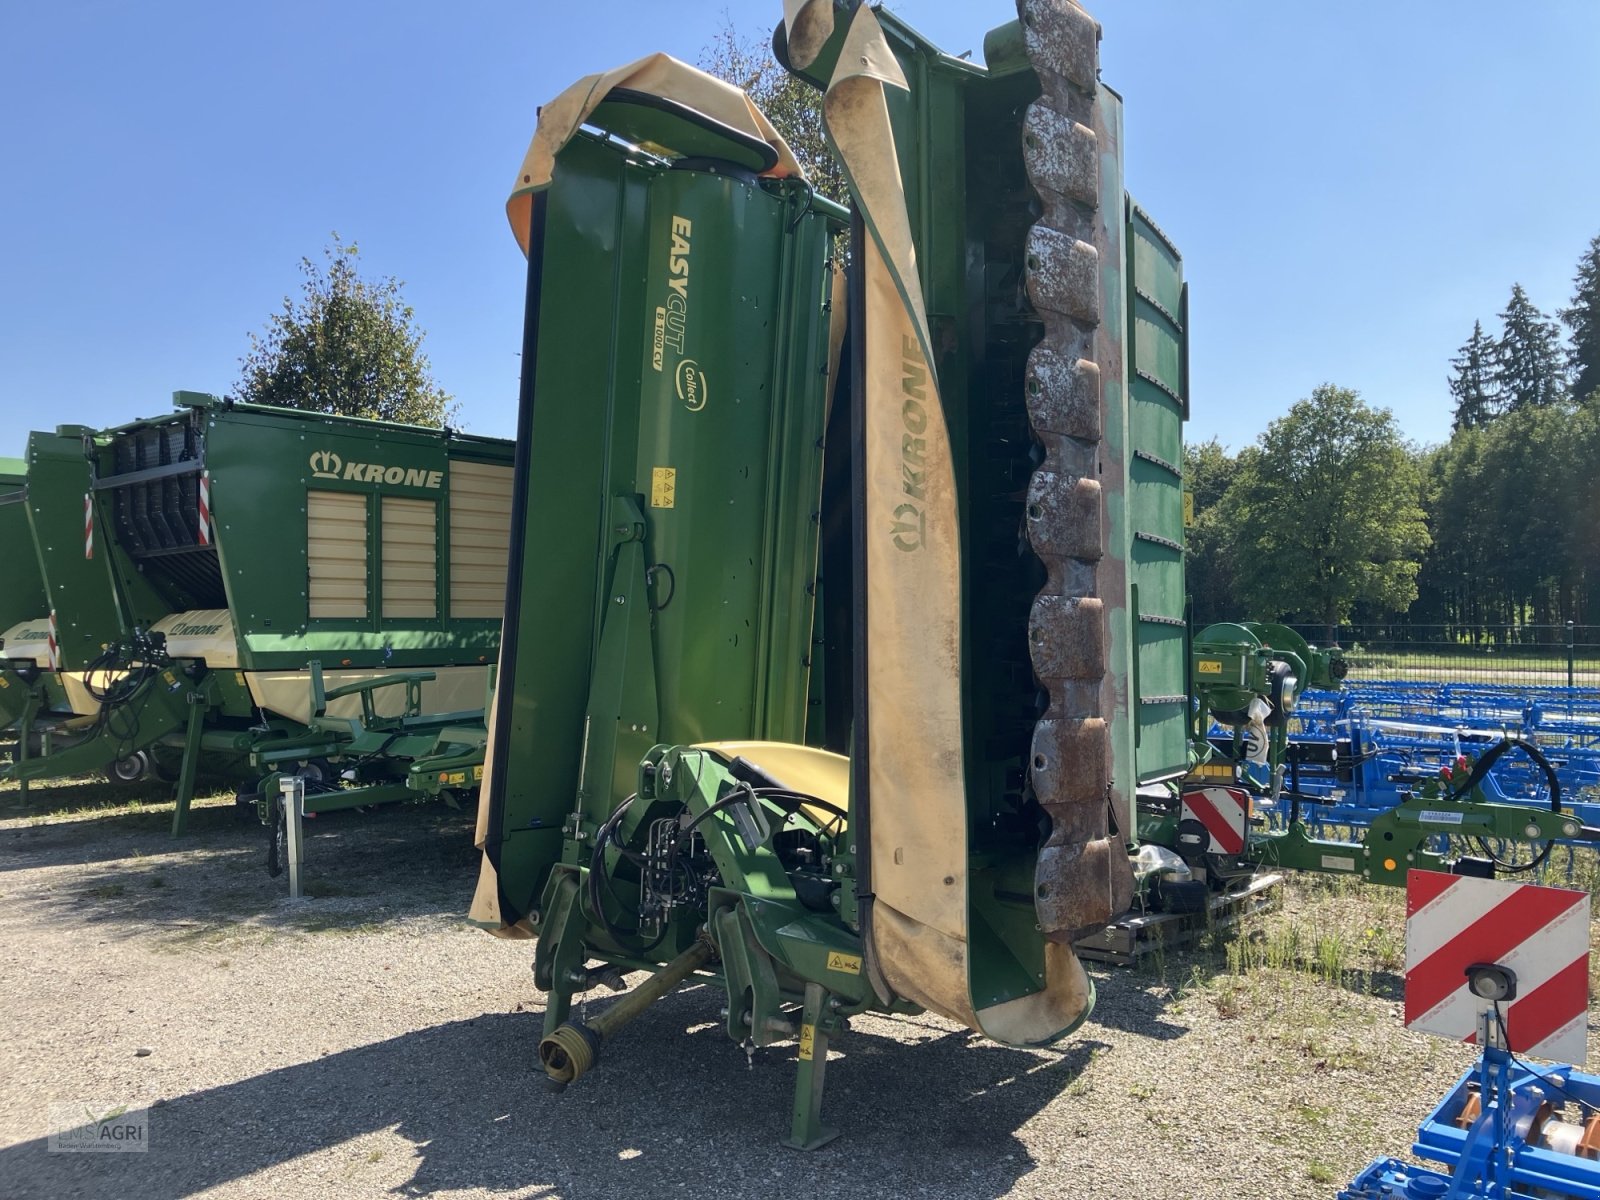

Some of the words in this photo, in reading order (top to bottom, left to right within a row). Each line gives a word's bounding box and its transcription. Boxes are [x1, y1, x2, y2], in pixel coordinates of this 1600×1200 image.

[656, 312, 665, 320] B
[654, 324, 664, 349] 1000
[653, 351, 663, 367] CV
[685, 367, 697, 404] Collect
[902, 334, 928, 500] KRONE
[343, 462, 444, 489] KRONE
[178, 625, 223, 636] KRONE
